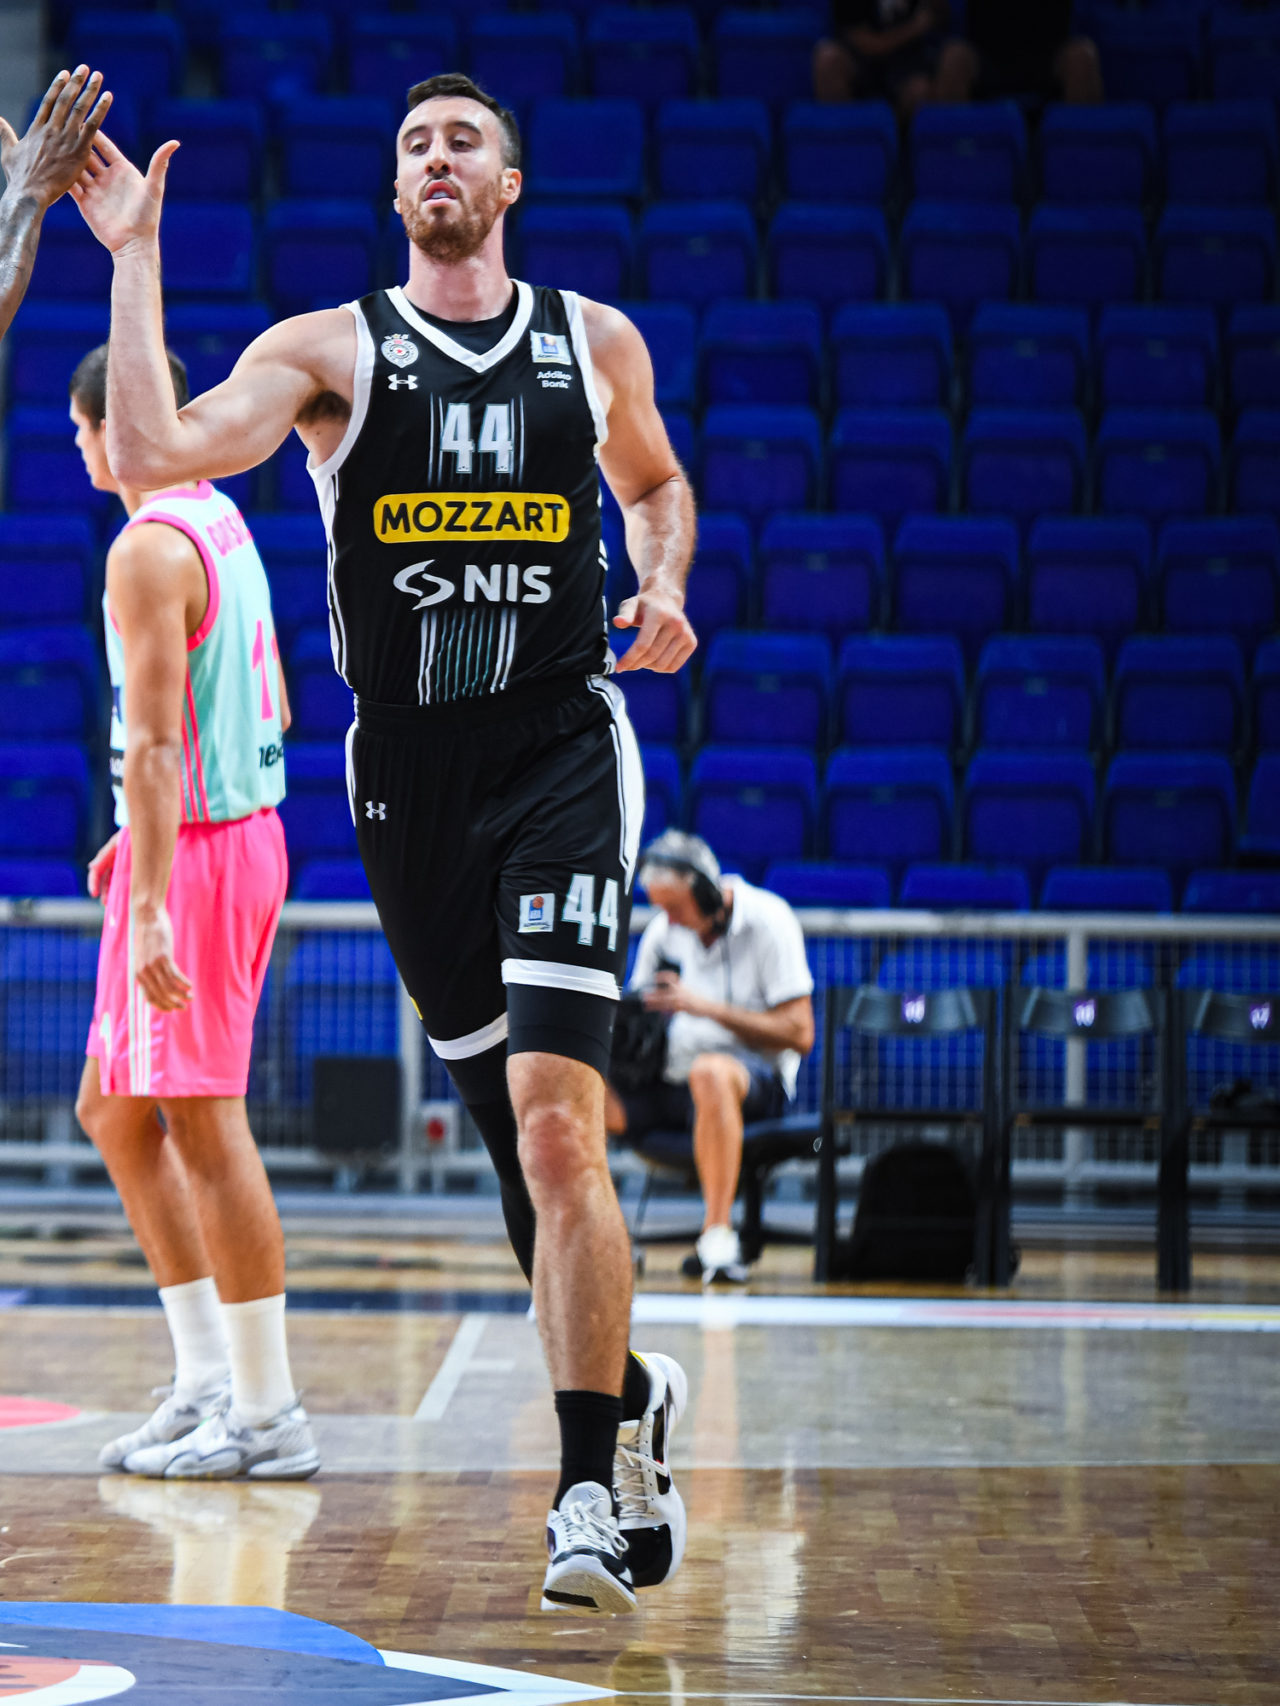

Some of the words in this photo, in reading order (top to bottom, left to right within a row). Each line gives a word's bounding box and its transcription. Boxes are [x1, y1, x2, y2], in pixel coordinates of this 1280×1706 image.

[440, 403, 514, 473] 44
[380, 501, 565, 535] MOZZART
[464, 564, 551, 604] NIS
[561, 873, 618, 952] 44
